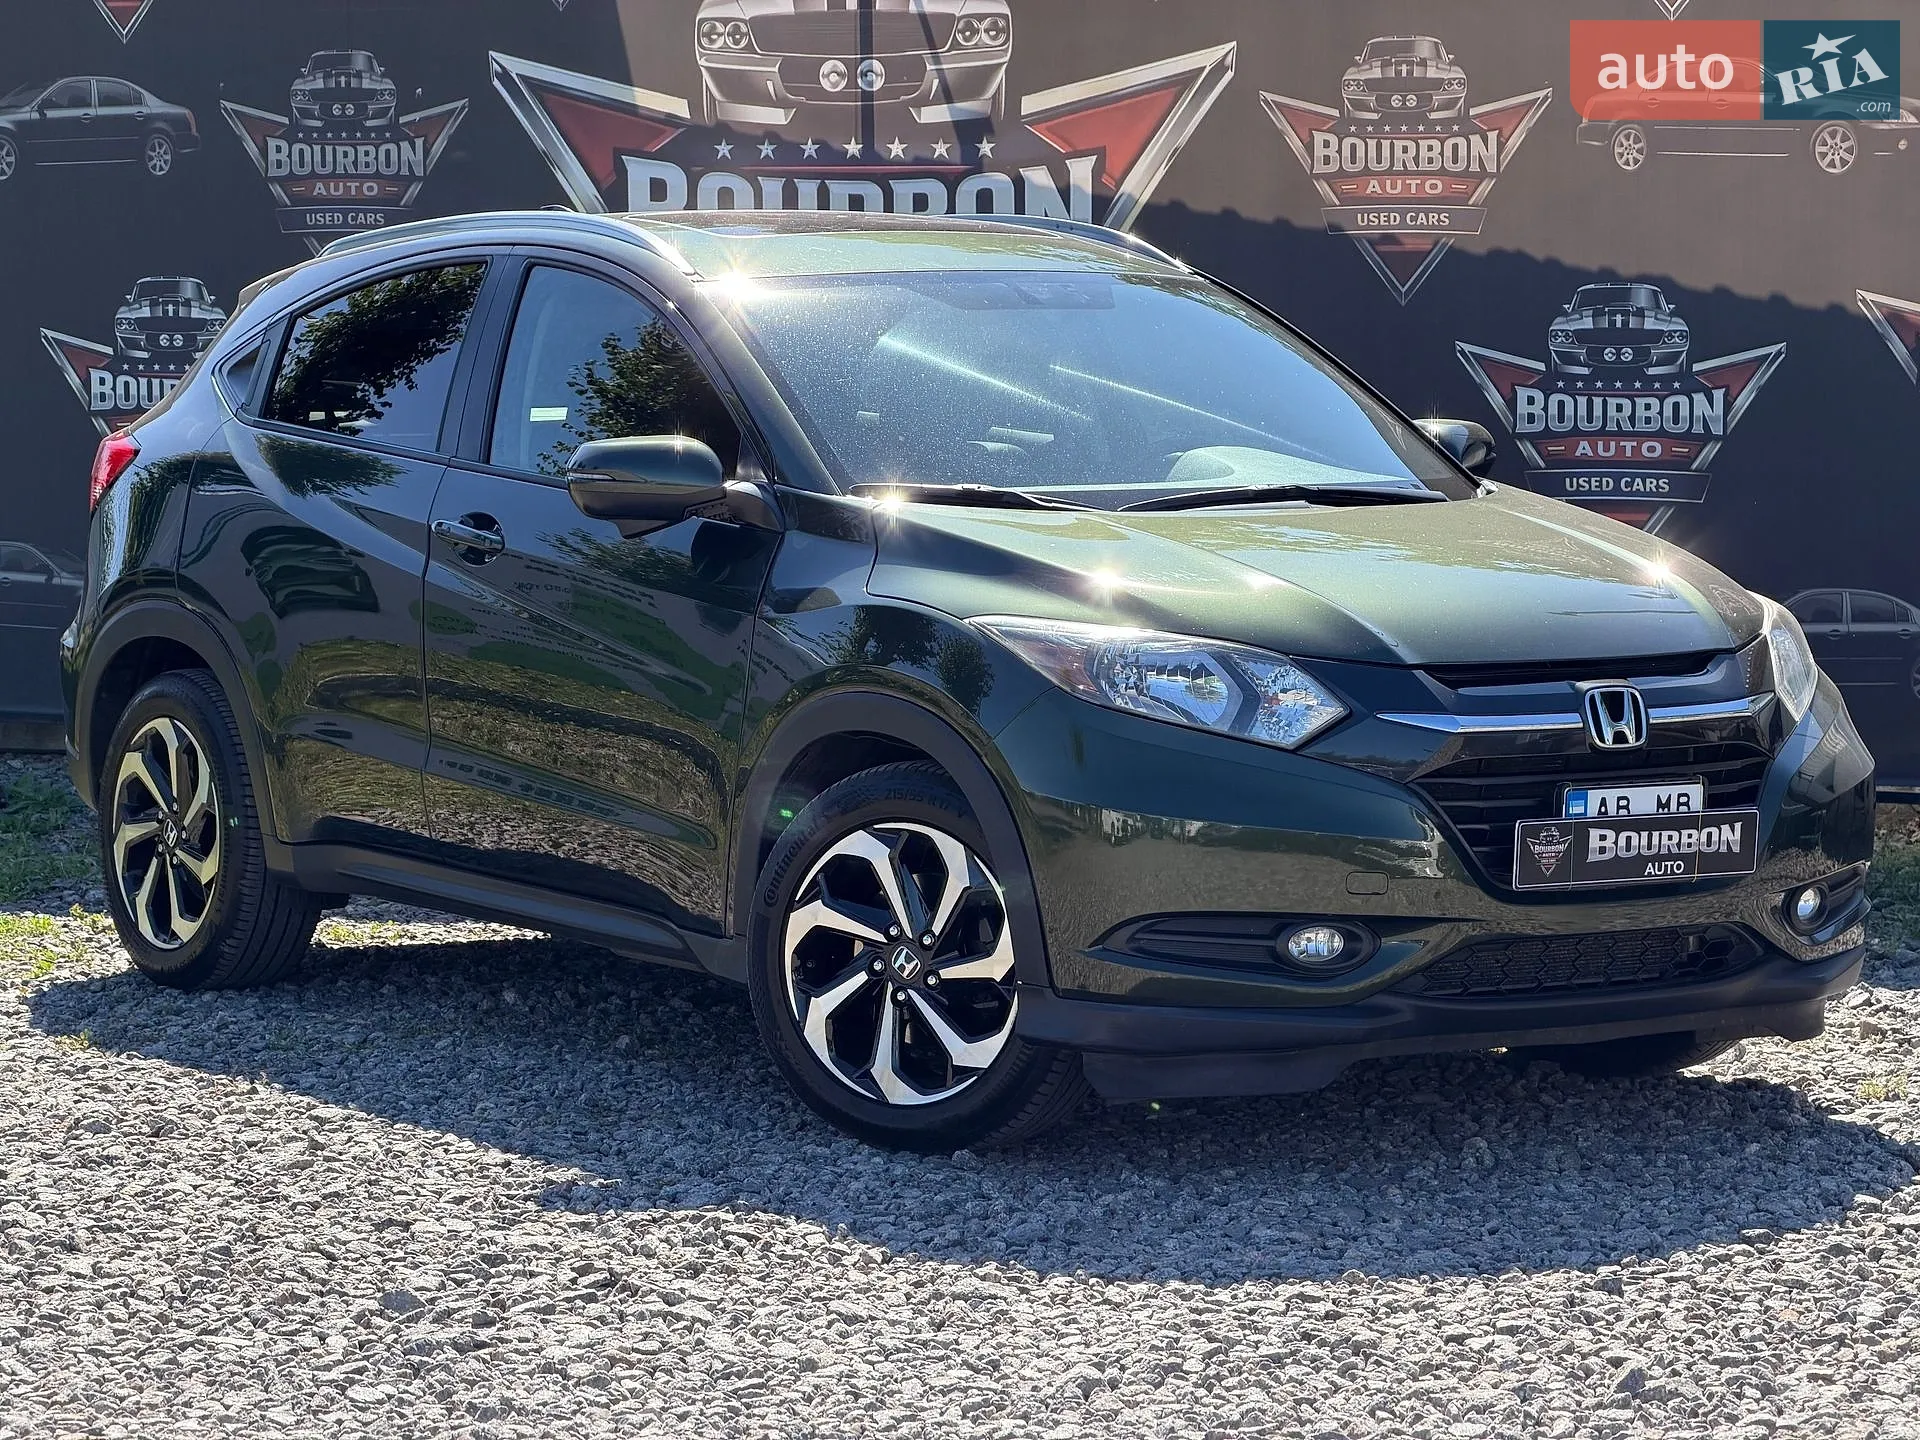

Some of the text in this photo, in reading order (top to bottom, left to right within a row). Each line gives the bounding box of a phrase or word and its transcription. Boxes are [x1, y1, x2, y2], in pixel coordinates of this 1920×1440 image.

[266, 136, 425, 177] BOURBON
[1312, 130, 1499, 174] BOURBON
[312, 182, 379, 196] AUTO
[1365, 179, 1443, 194] AUTO
[306, 212, 385, 225] USED CARS
[1357, 212, 1450, 226] USED CARS
[1514, 385, 1726, 435] BOURBON
[1575, 440, 1662, 458] AUTO
[1565, 477, 1670, 493] USED CARS
[1586, 821, 1743, 863] BOURBON
[1644, 860, 1684, 876] AUTO
